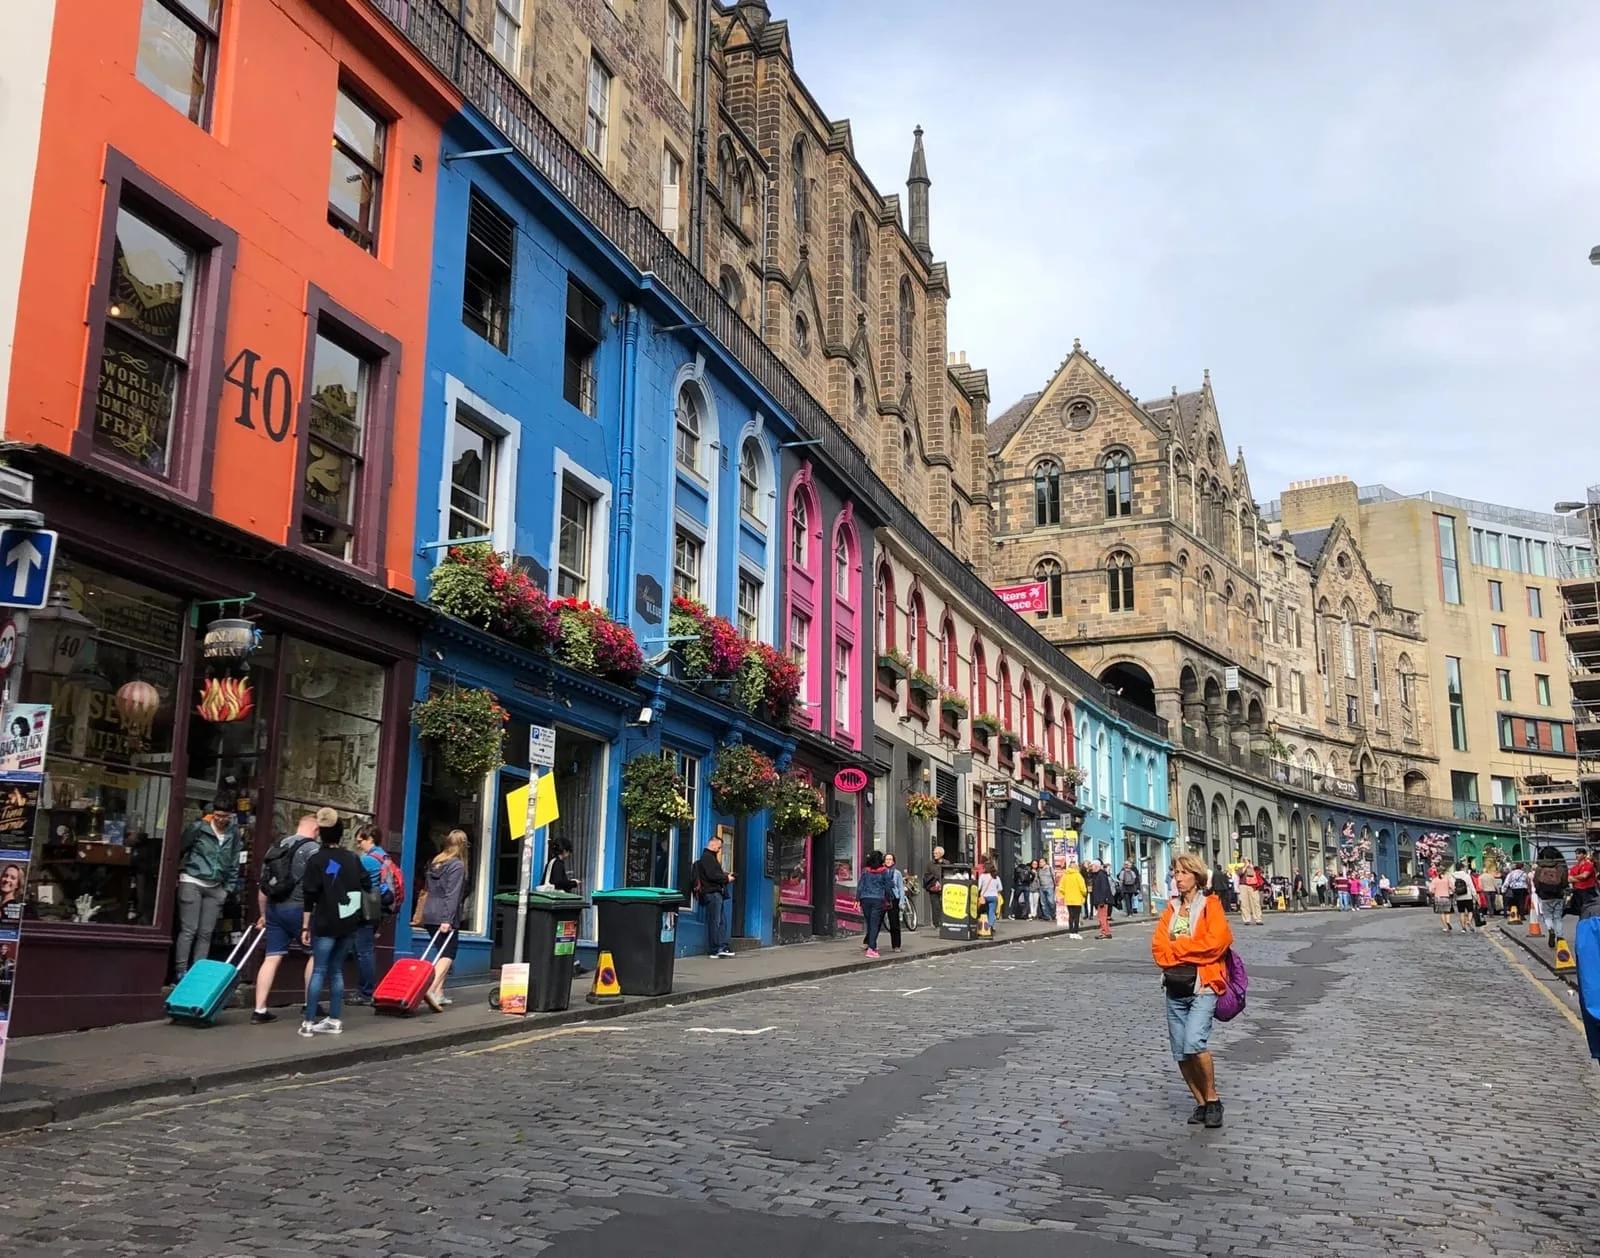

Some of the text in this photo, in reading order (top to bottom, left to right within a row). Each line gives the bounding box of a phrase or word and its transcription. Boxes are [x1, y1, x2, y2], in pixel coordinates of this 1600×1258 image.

[98, 375, 161, 413] FAMOUS
[104, 359, 161, 397] WORLD
[224, 348, 292, 442] 40
[97, 393, 162, 431] DMISSIO
[101, 411, 146, 442] FRE
[58, 635, 80, 658] 40
[50, 680, 153, 740] MUSEM
[66, 724, 130, 755] CNTEXT
